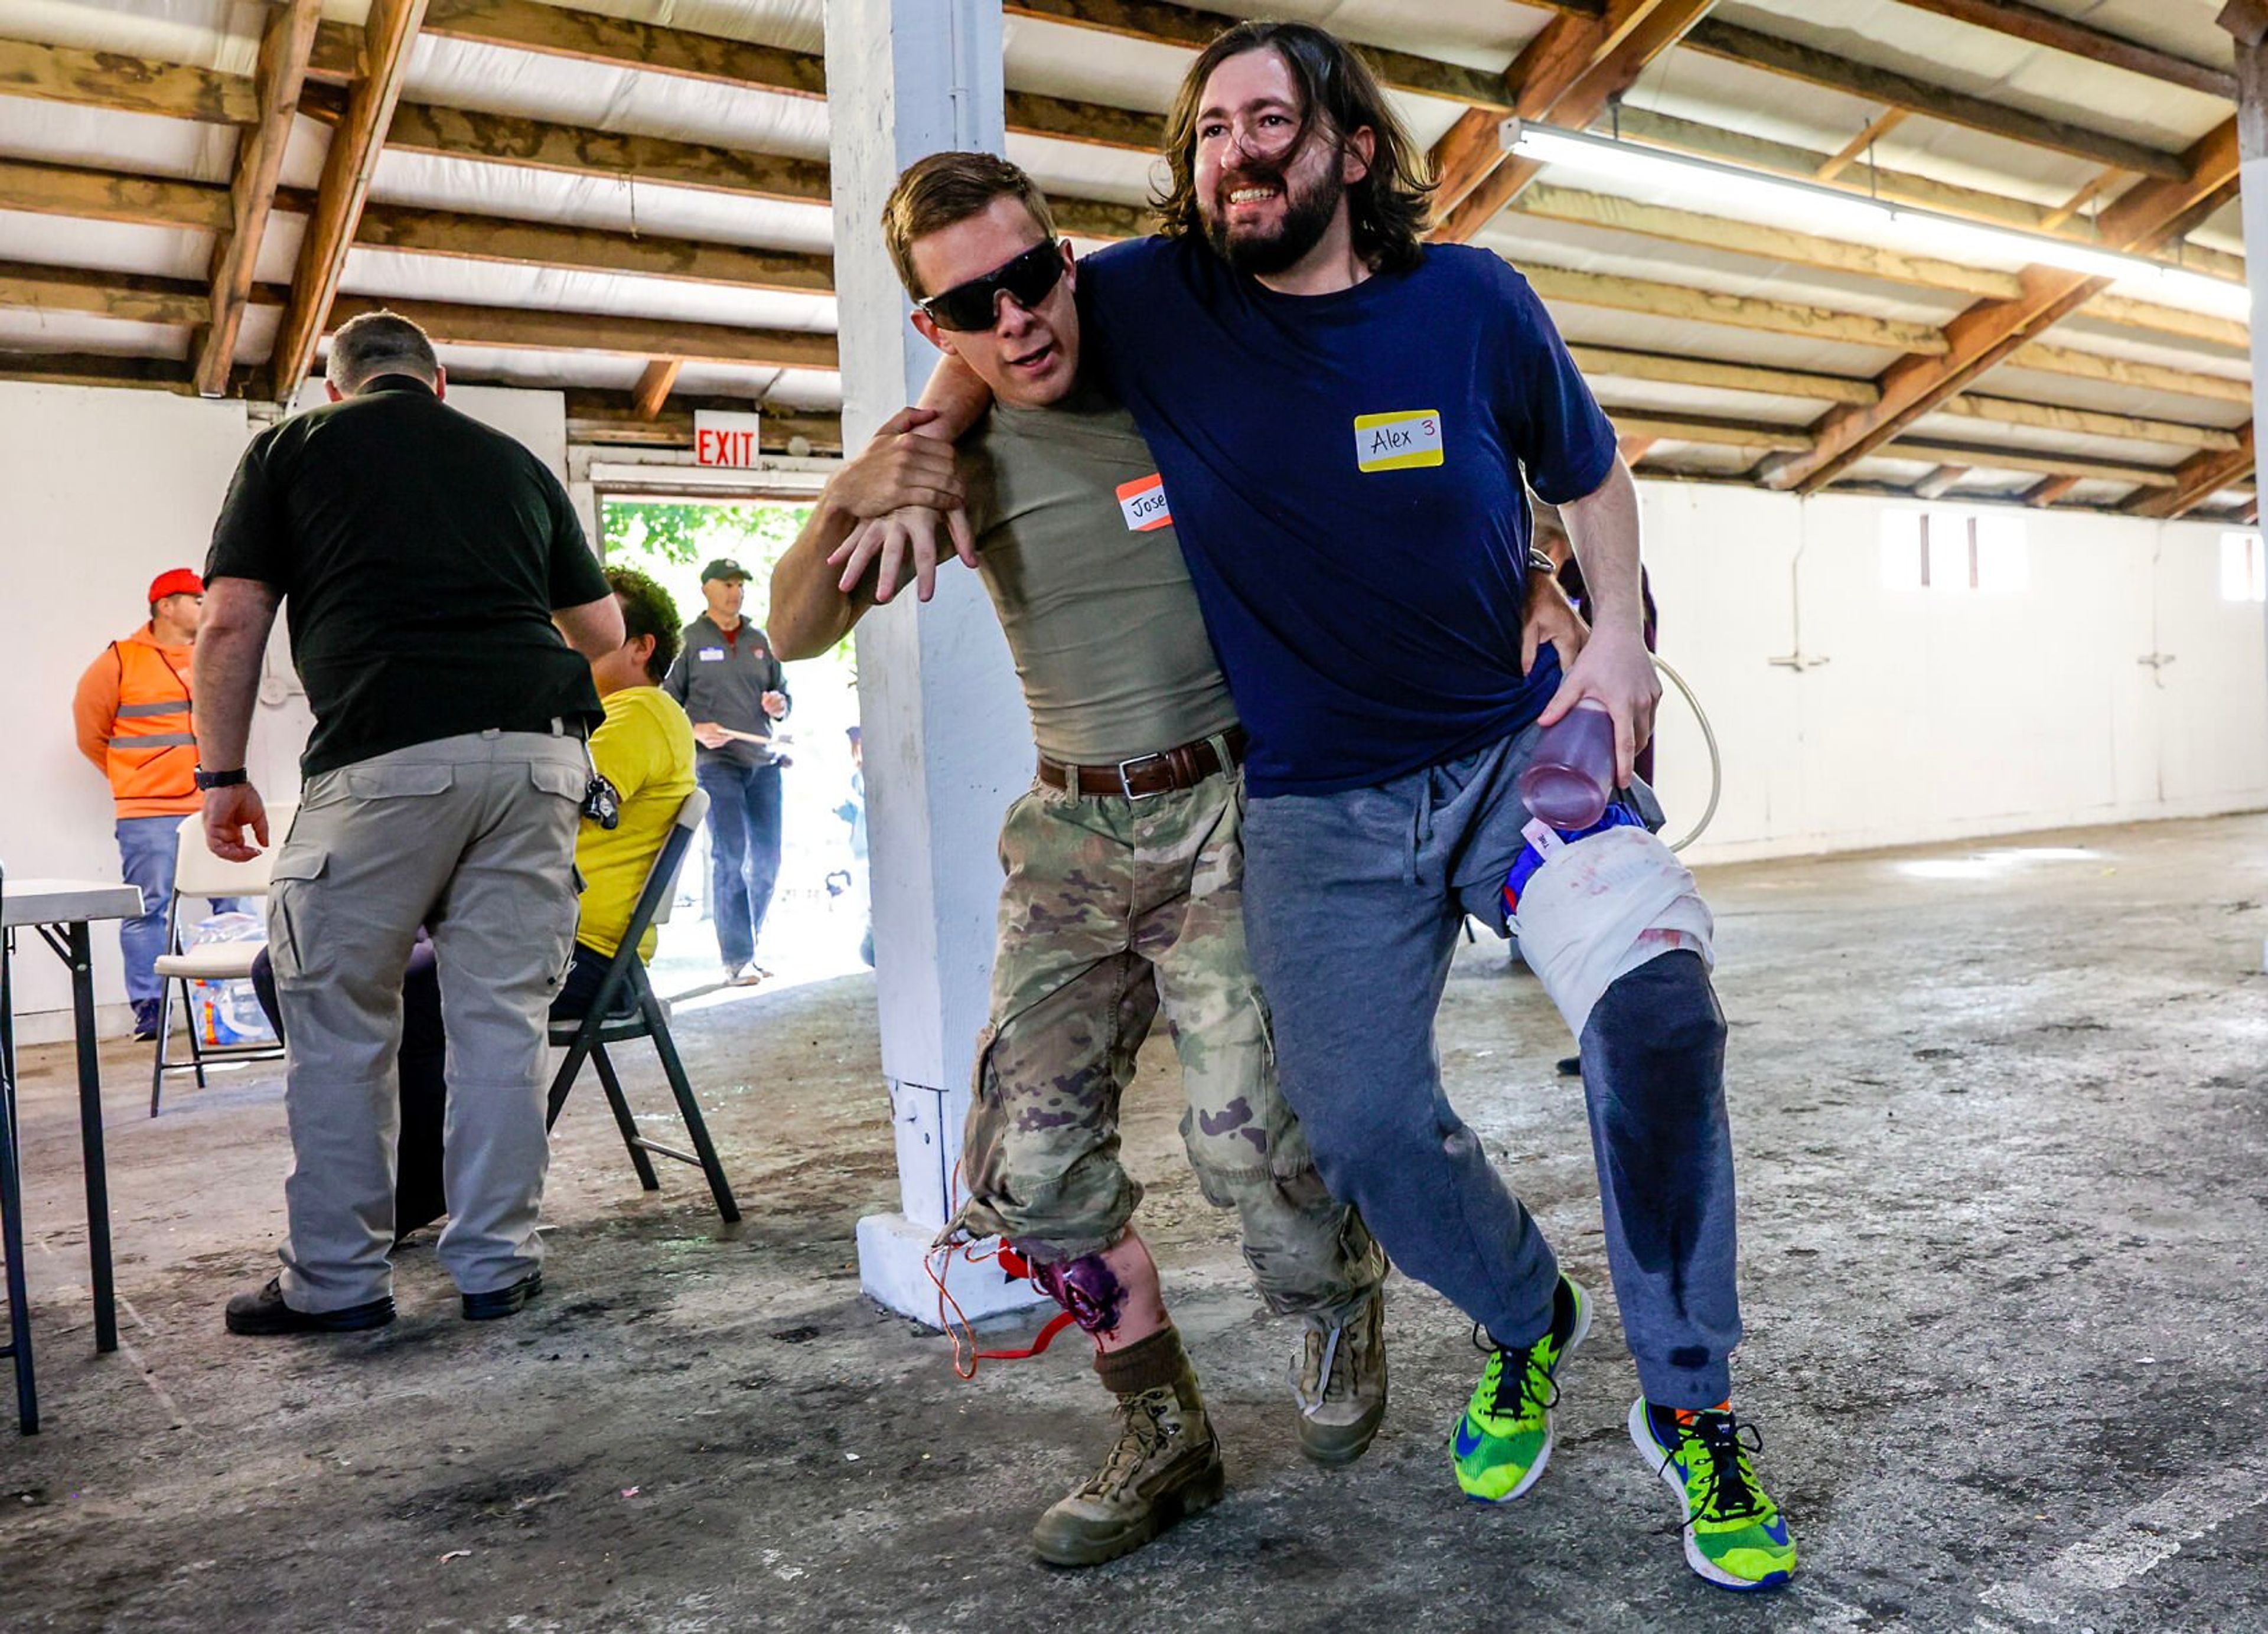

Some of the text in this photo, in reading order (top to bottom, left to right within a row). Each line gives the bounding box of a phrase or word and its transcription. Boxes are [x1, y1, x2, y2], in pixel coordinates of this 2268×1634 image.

[699, 429, 754, 467] EXIT
[1371, 420, 1435, 454] Alex 3
[1131, 495, 1166, 517] Jose
